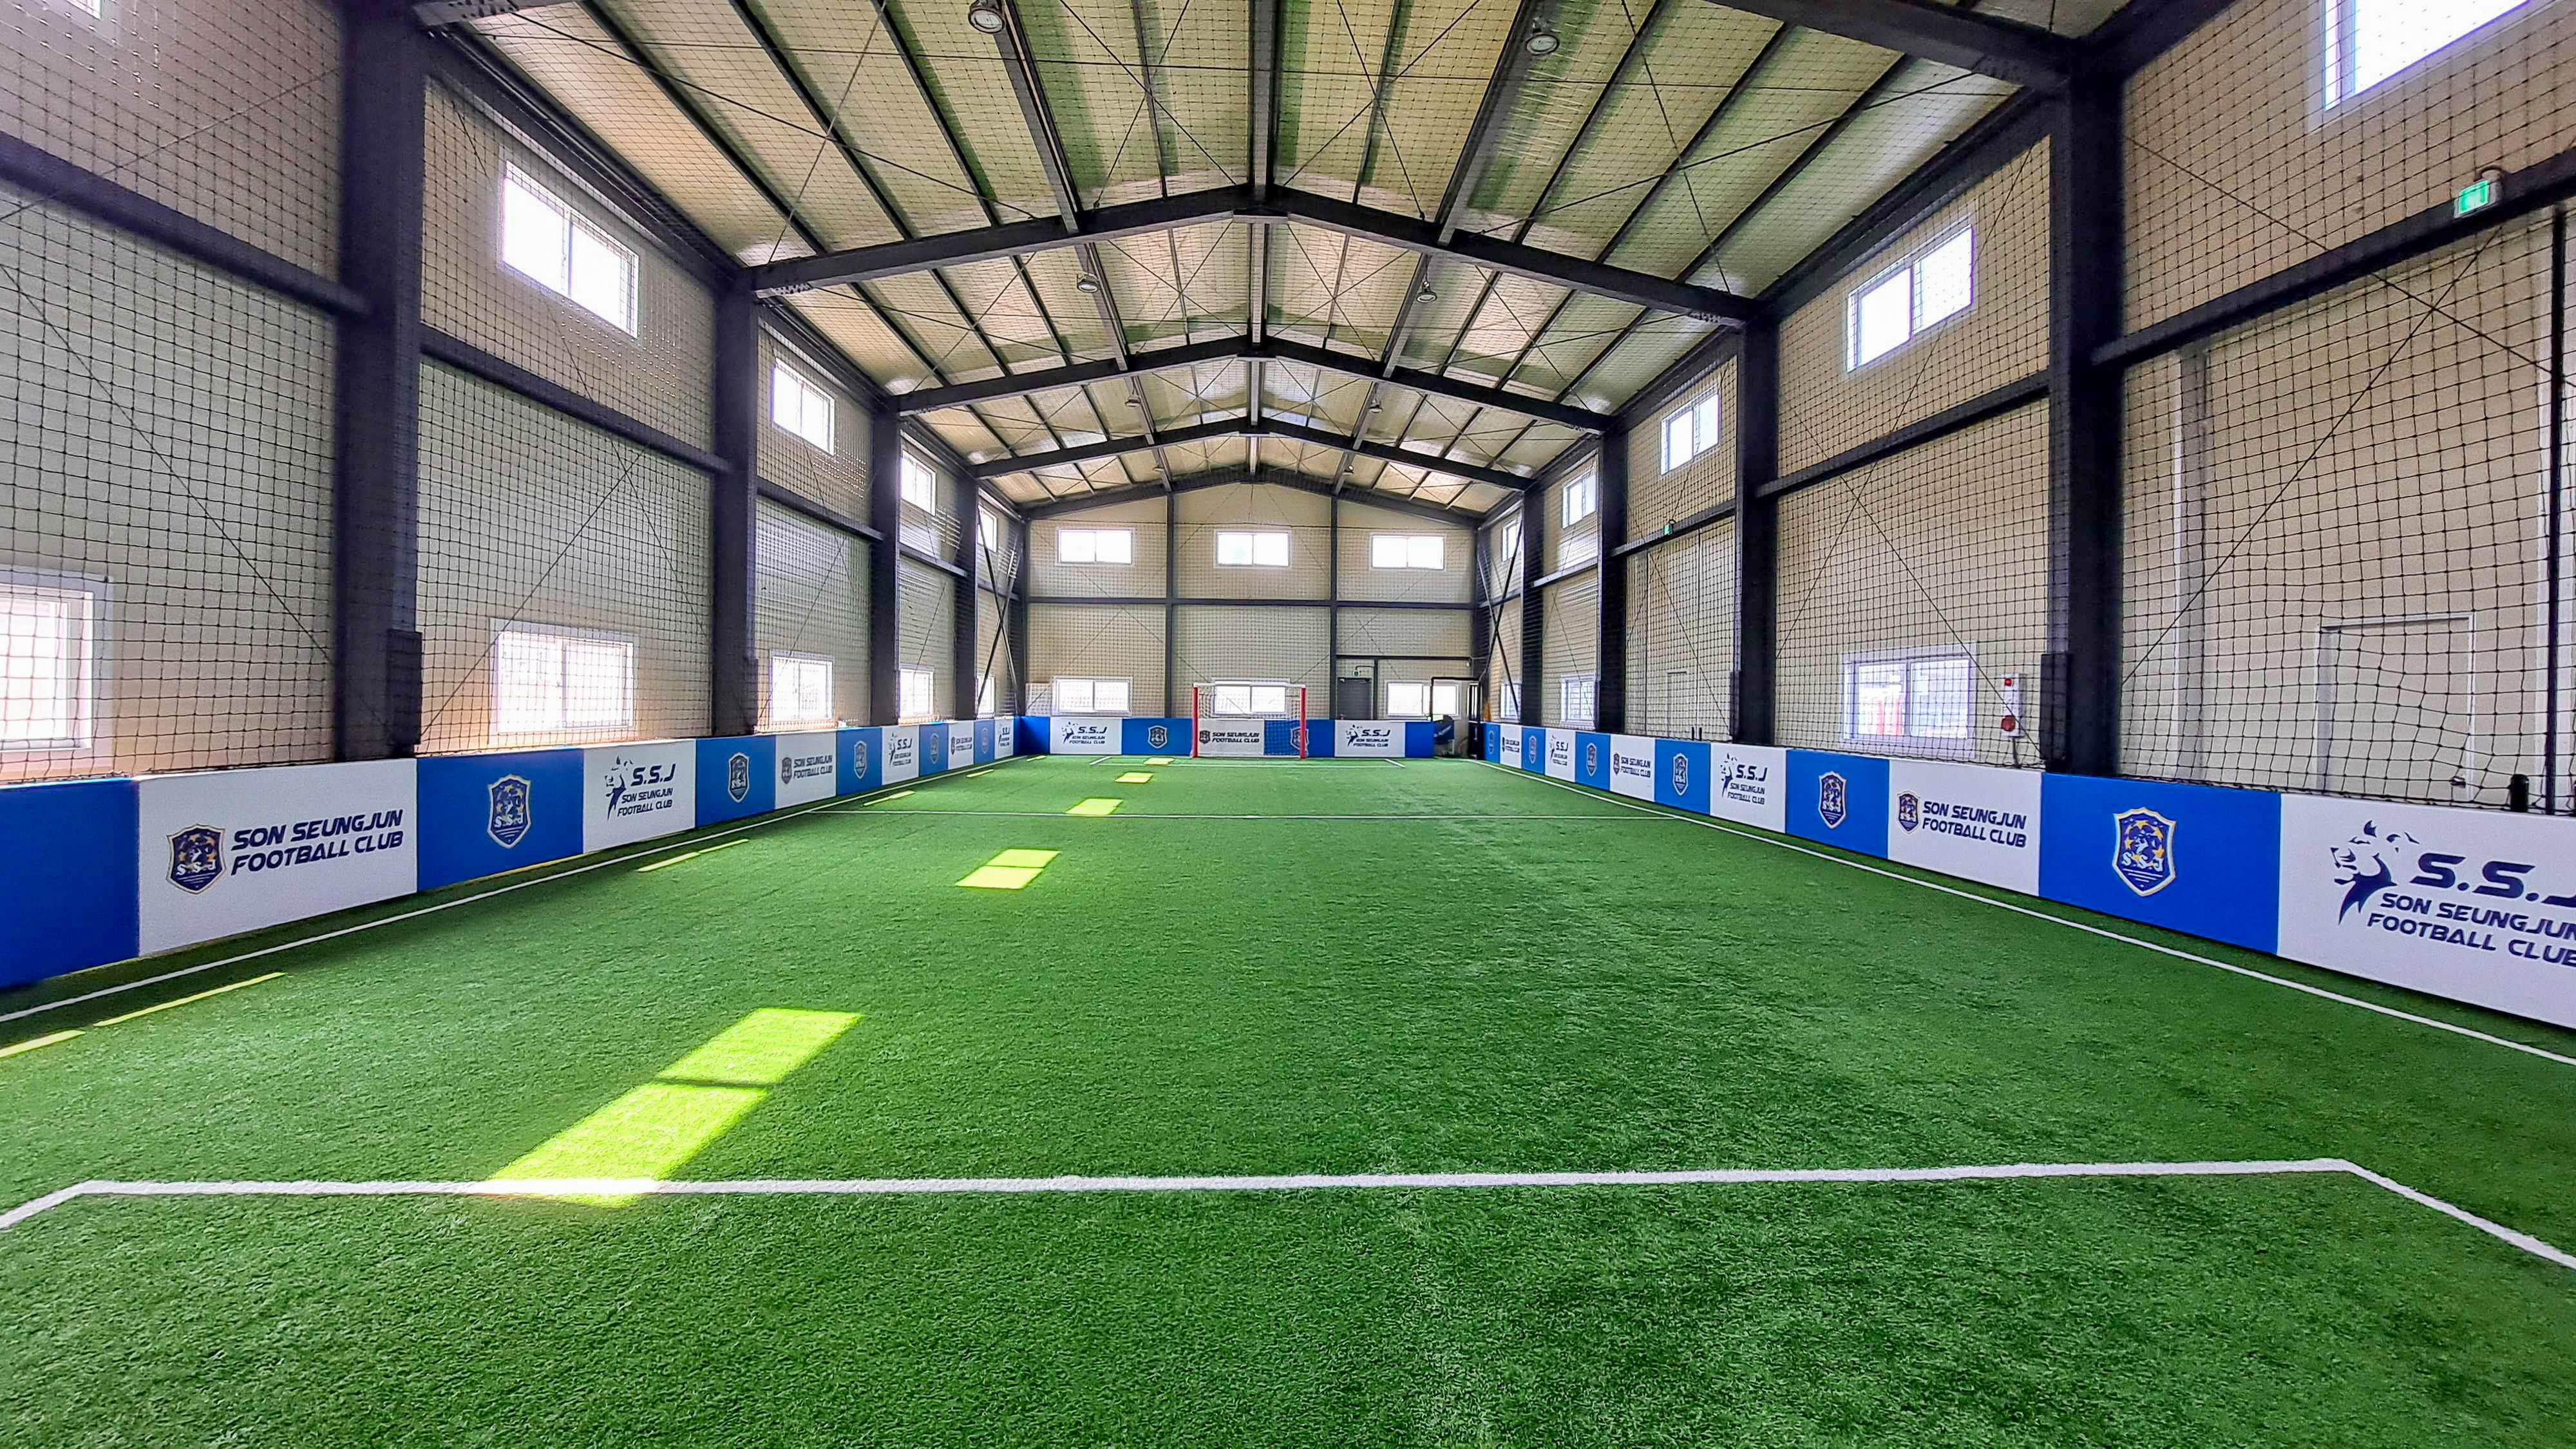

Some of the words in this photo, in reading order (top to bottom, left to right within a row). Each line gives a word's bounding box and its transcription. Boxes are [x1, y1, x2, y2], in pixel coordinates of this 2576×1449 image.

[630, 764, 676, 786] S.S.J
[1736, 764, 1767, 782] S.S.J
[618, 802, 654, 817] FOOTBALL
[656, 799, 673, 810] CLUB
[621, 793, 637, 804] SON
[638, 788, 673, 800] SEUNGJUN
[1922, 801, 1949, 817] SON
[1951, 805, 2027, 829] SEUNGJUN
[231, 825, 287, 851] SON
[290, 810, 403, 842] SEUNGJUN
[1922, 817, 1986, 840] FOOTBALL
[1990, 829, 2027, 848] CLUB
[231, 840, 350, 876] FOOTBALL
[354, 831, 404, 853] CLUB
[2380, 893, 2432, 914] SON
[2367, 913, 2496, 951] FOOTBALL
